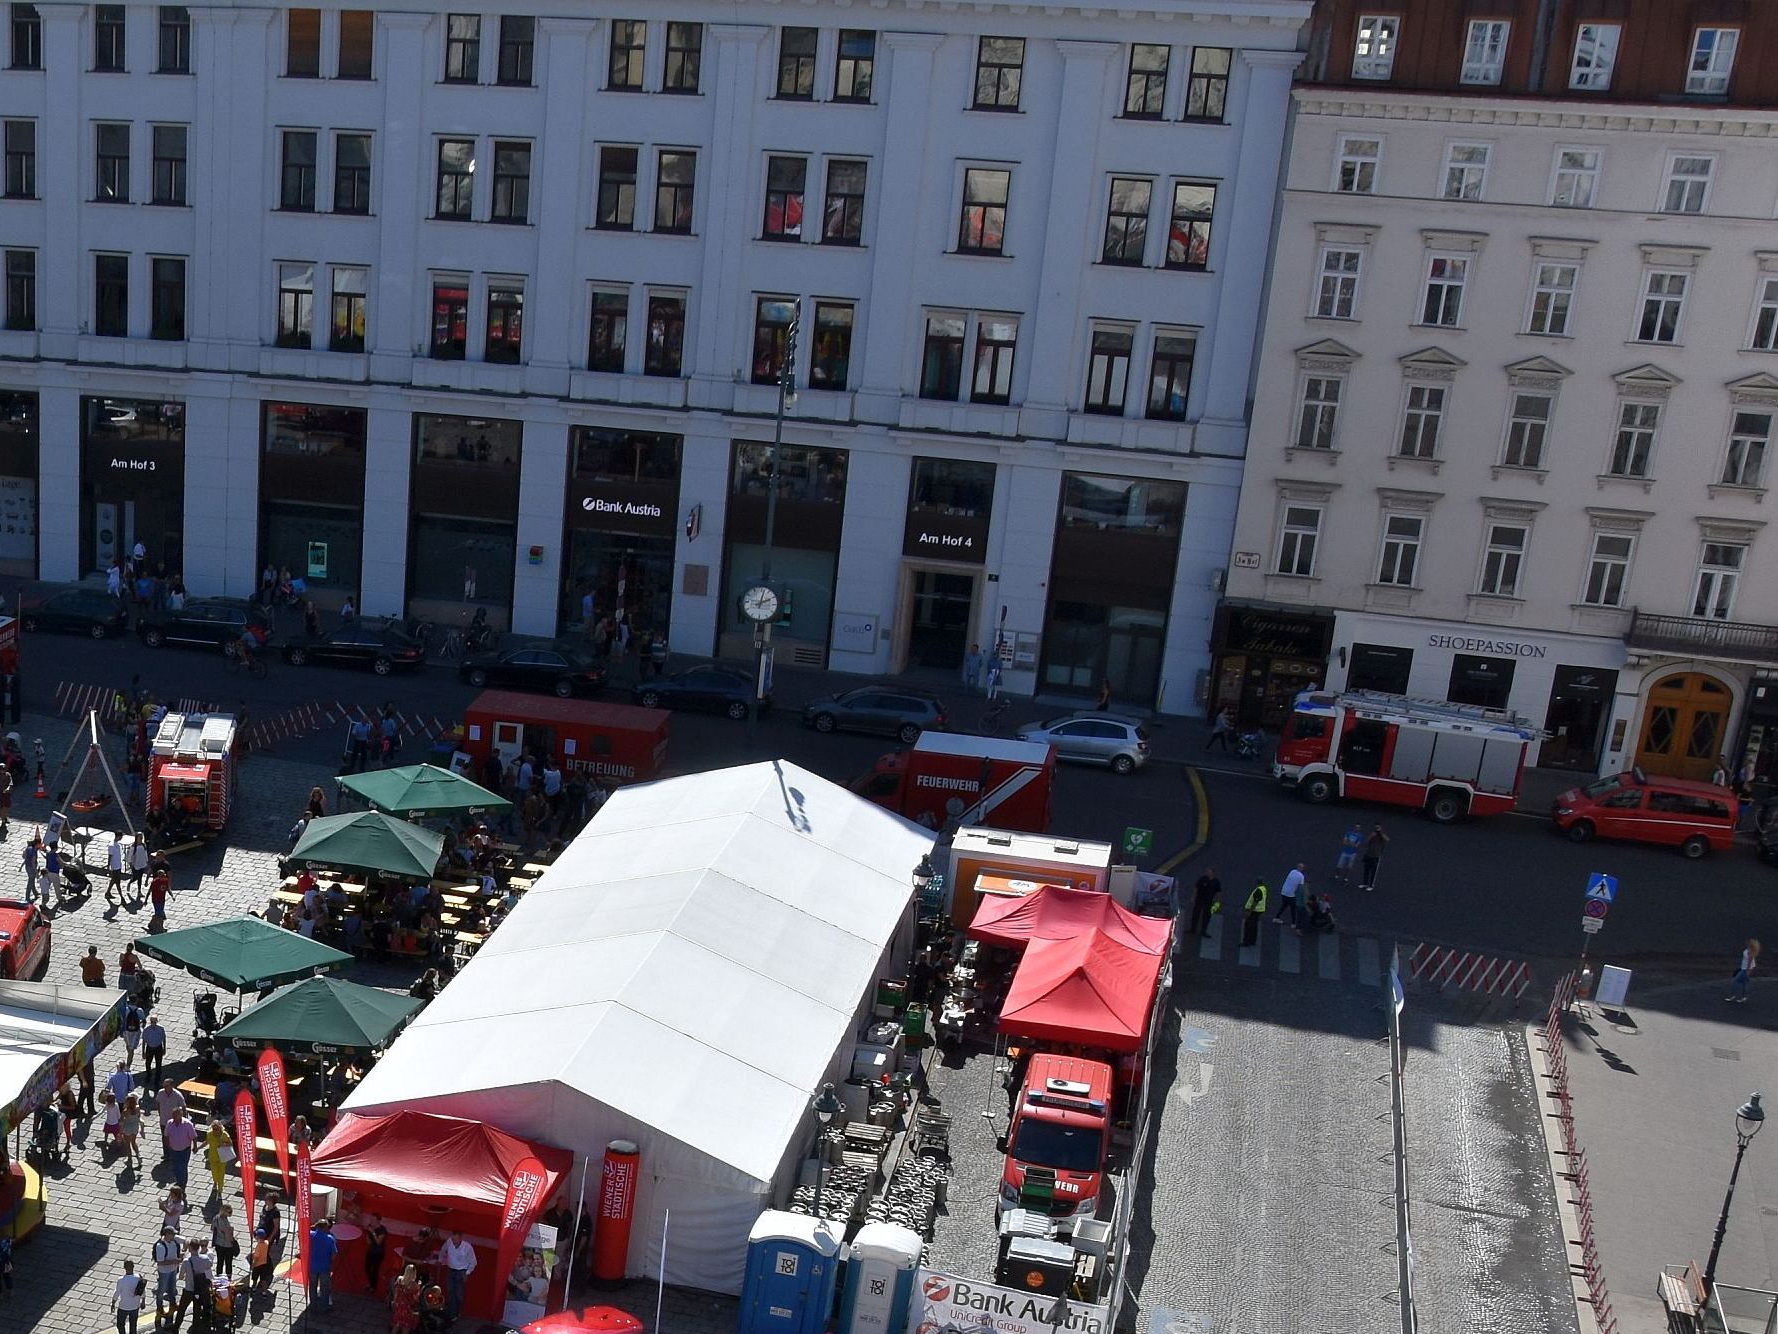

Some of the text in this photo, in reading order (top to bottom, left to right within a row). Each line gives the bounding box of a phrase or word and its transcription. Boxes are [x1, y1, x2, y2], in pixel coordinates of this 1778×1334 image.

[112, 458, 156, 471] Am Hof 3
[596, 500, 660, 517] Bank Austria
[919, 532, 972, 547] Am Hof 4
[1428, 634, 1547, 658] SHOEPASSION
[566, 758, 635, 778] BETREUUNG
[917, 774, 980, 793] FEUERWEHR
[232, 1038, 257, 1048] Gösser
[312, 1042, 337, 1054] Gösser
[602, 1176, 614, 1218] WIENER
[610, 1162, 627, 1220] STÄDTISCHE
[504, 1184, 526, 1230] WIENER
[952, 1283, 1016, 1318] Bank
[950, 1310, 994, 1330] UniCredit
